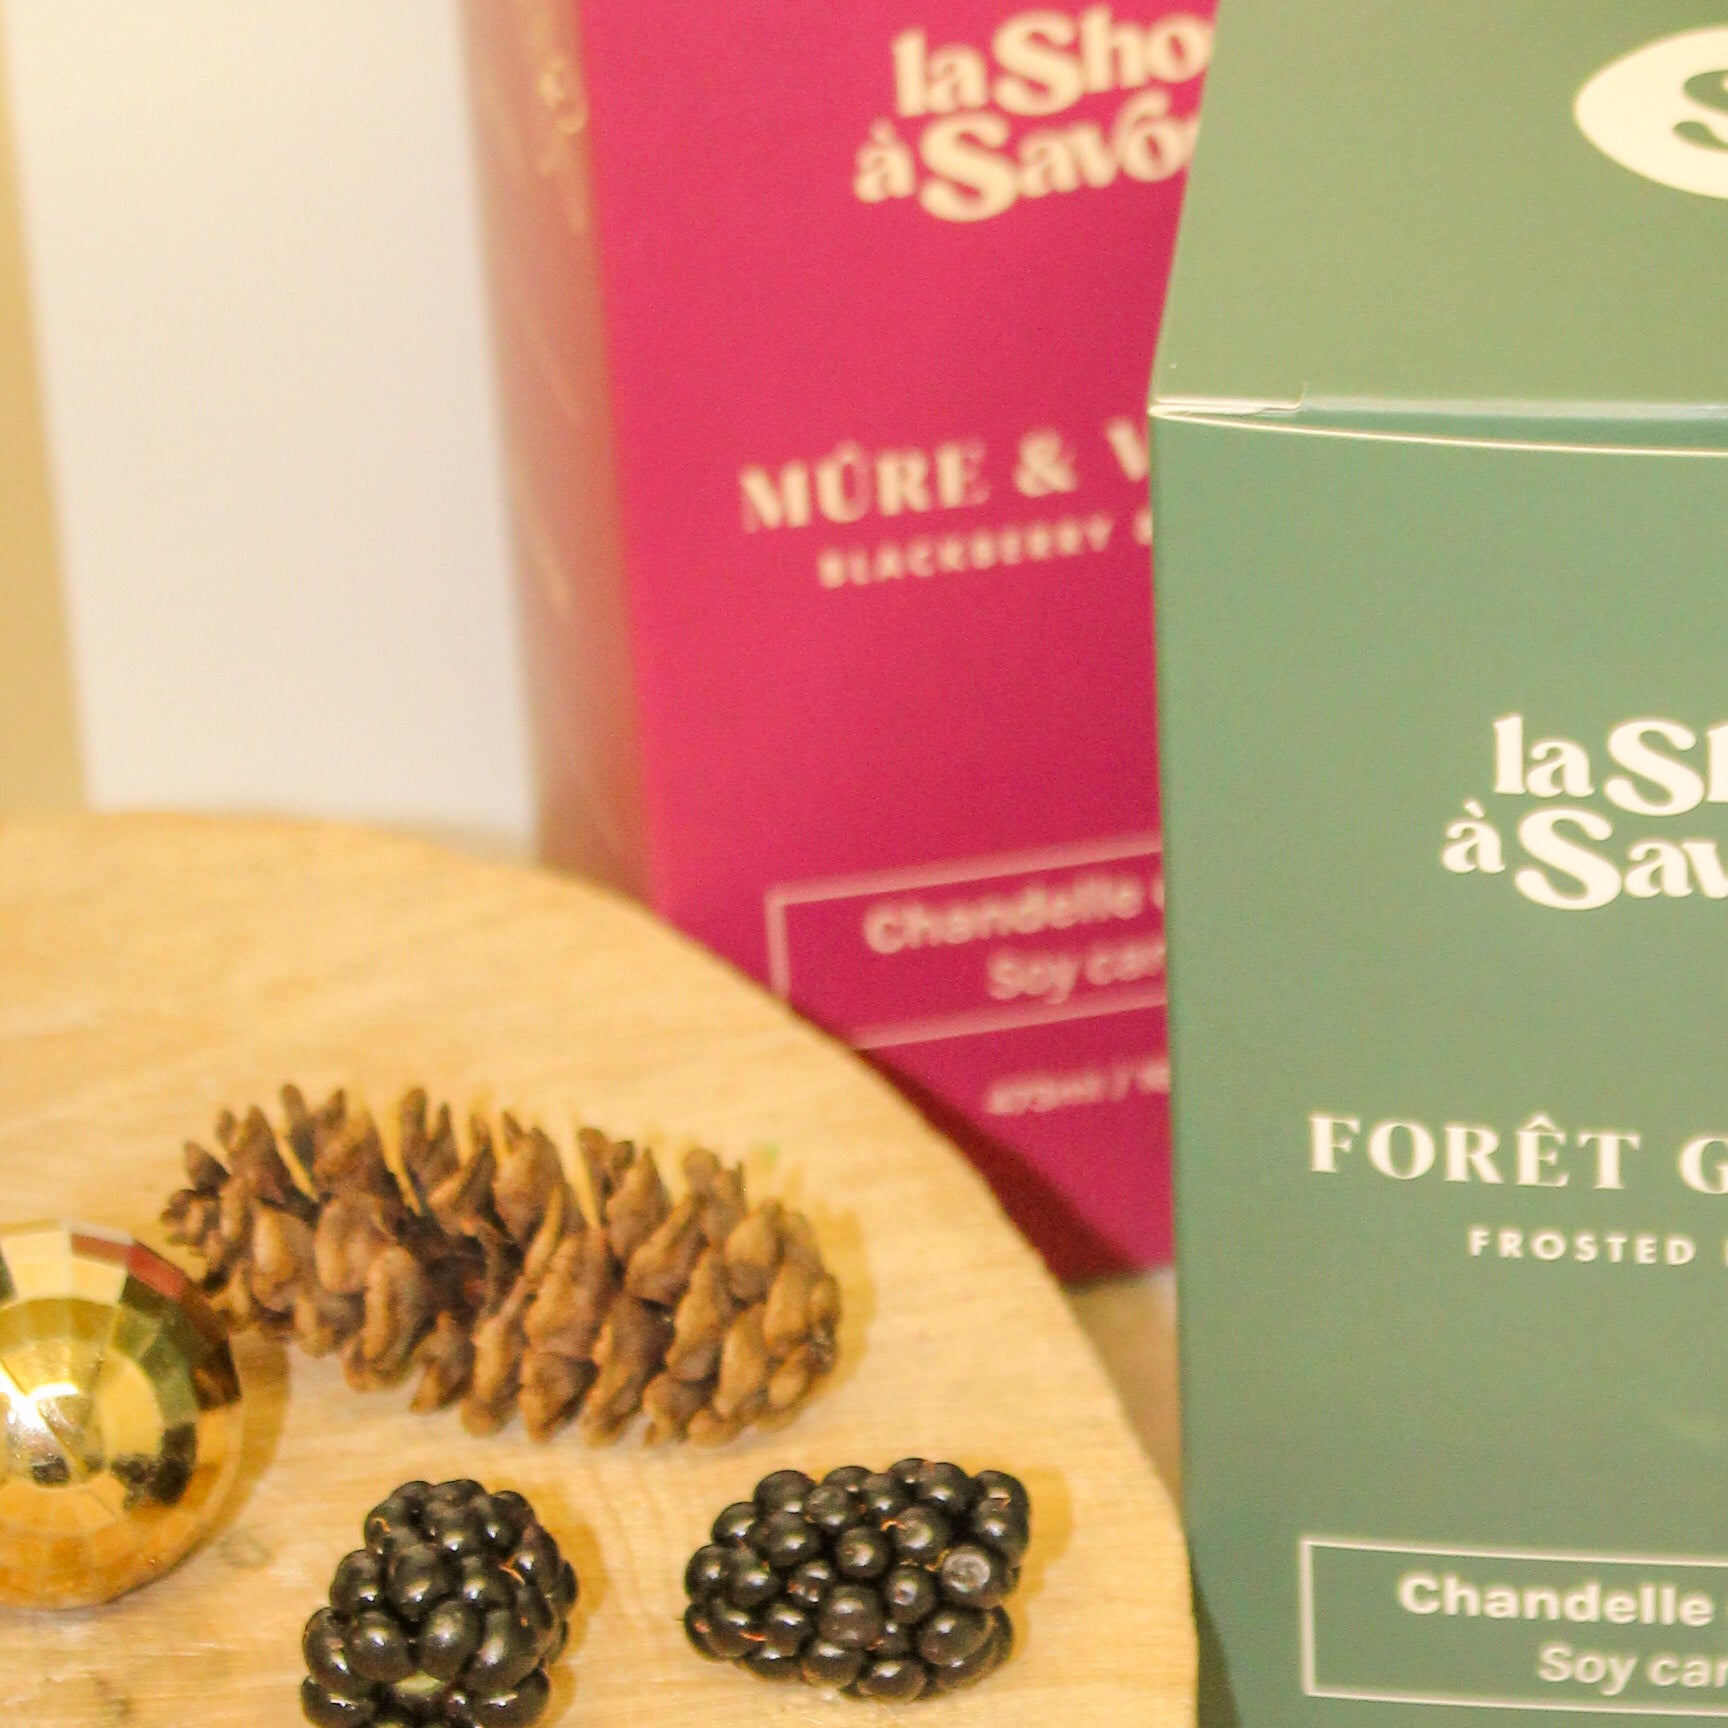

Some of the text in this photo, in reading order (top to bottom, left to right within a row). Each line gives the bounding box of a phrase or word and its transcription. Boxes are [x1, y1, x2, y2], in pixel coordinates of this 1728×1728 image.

[892, 2, 1214, 119] la Sho
[918, 87, 1200, 224] Savo
[1013, 425, 1077, 498] &
[1493, 713, 1595, 798] la
[1441, 798, 1505, 874] à
[1307, 1113, 1641, 1190] FORÊT
[1466, 1229, 1697, 1267] FROSTED
[1398, 1572, 1714, 1627] Chandelle
[1537, 1643, 1636, 1695] Soy
